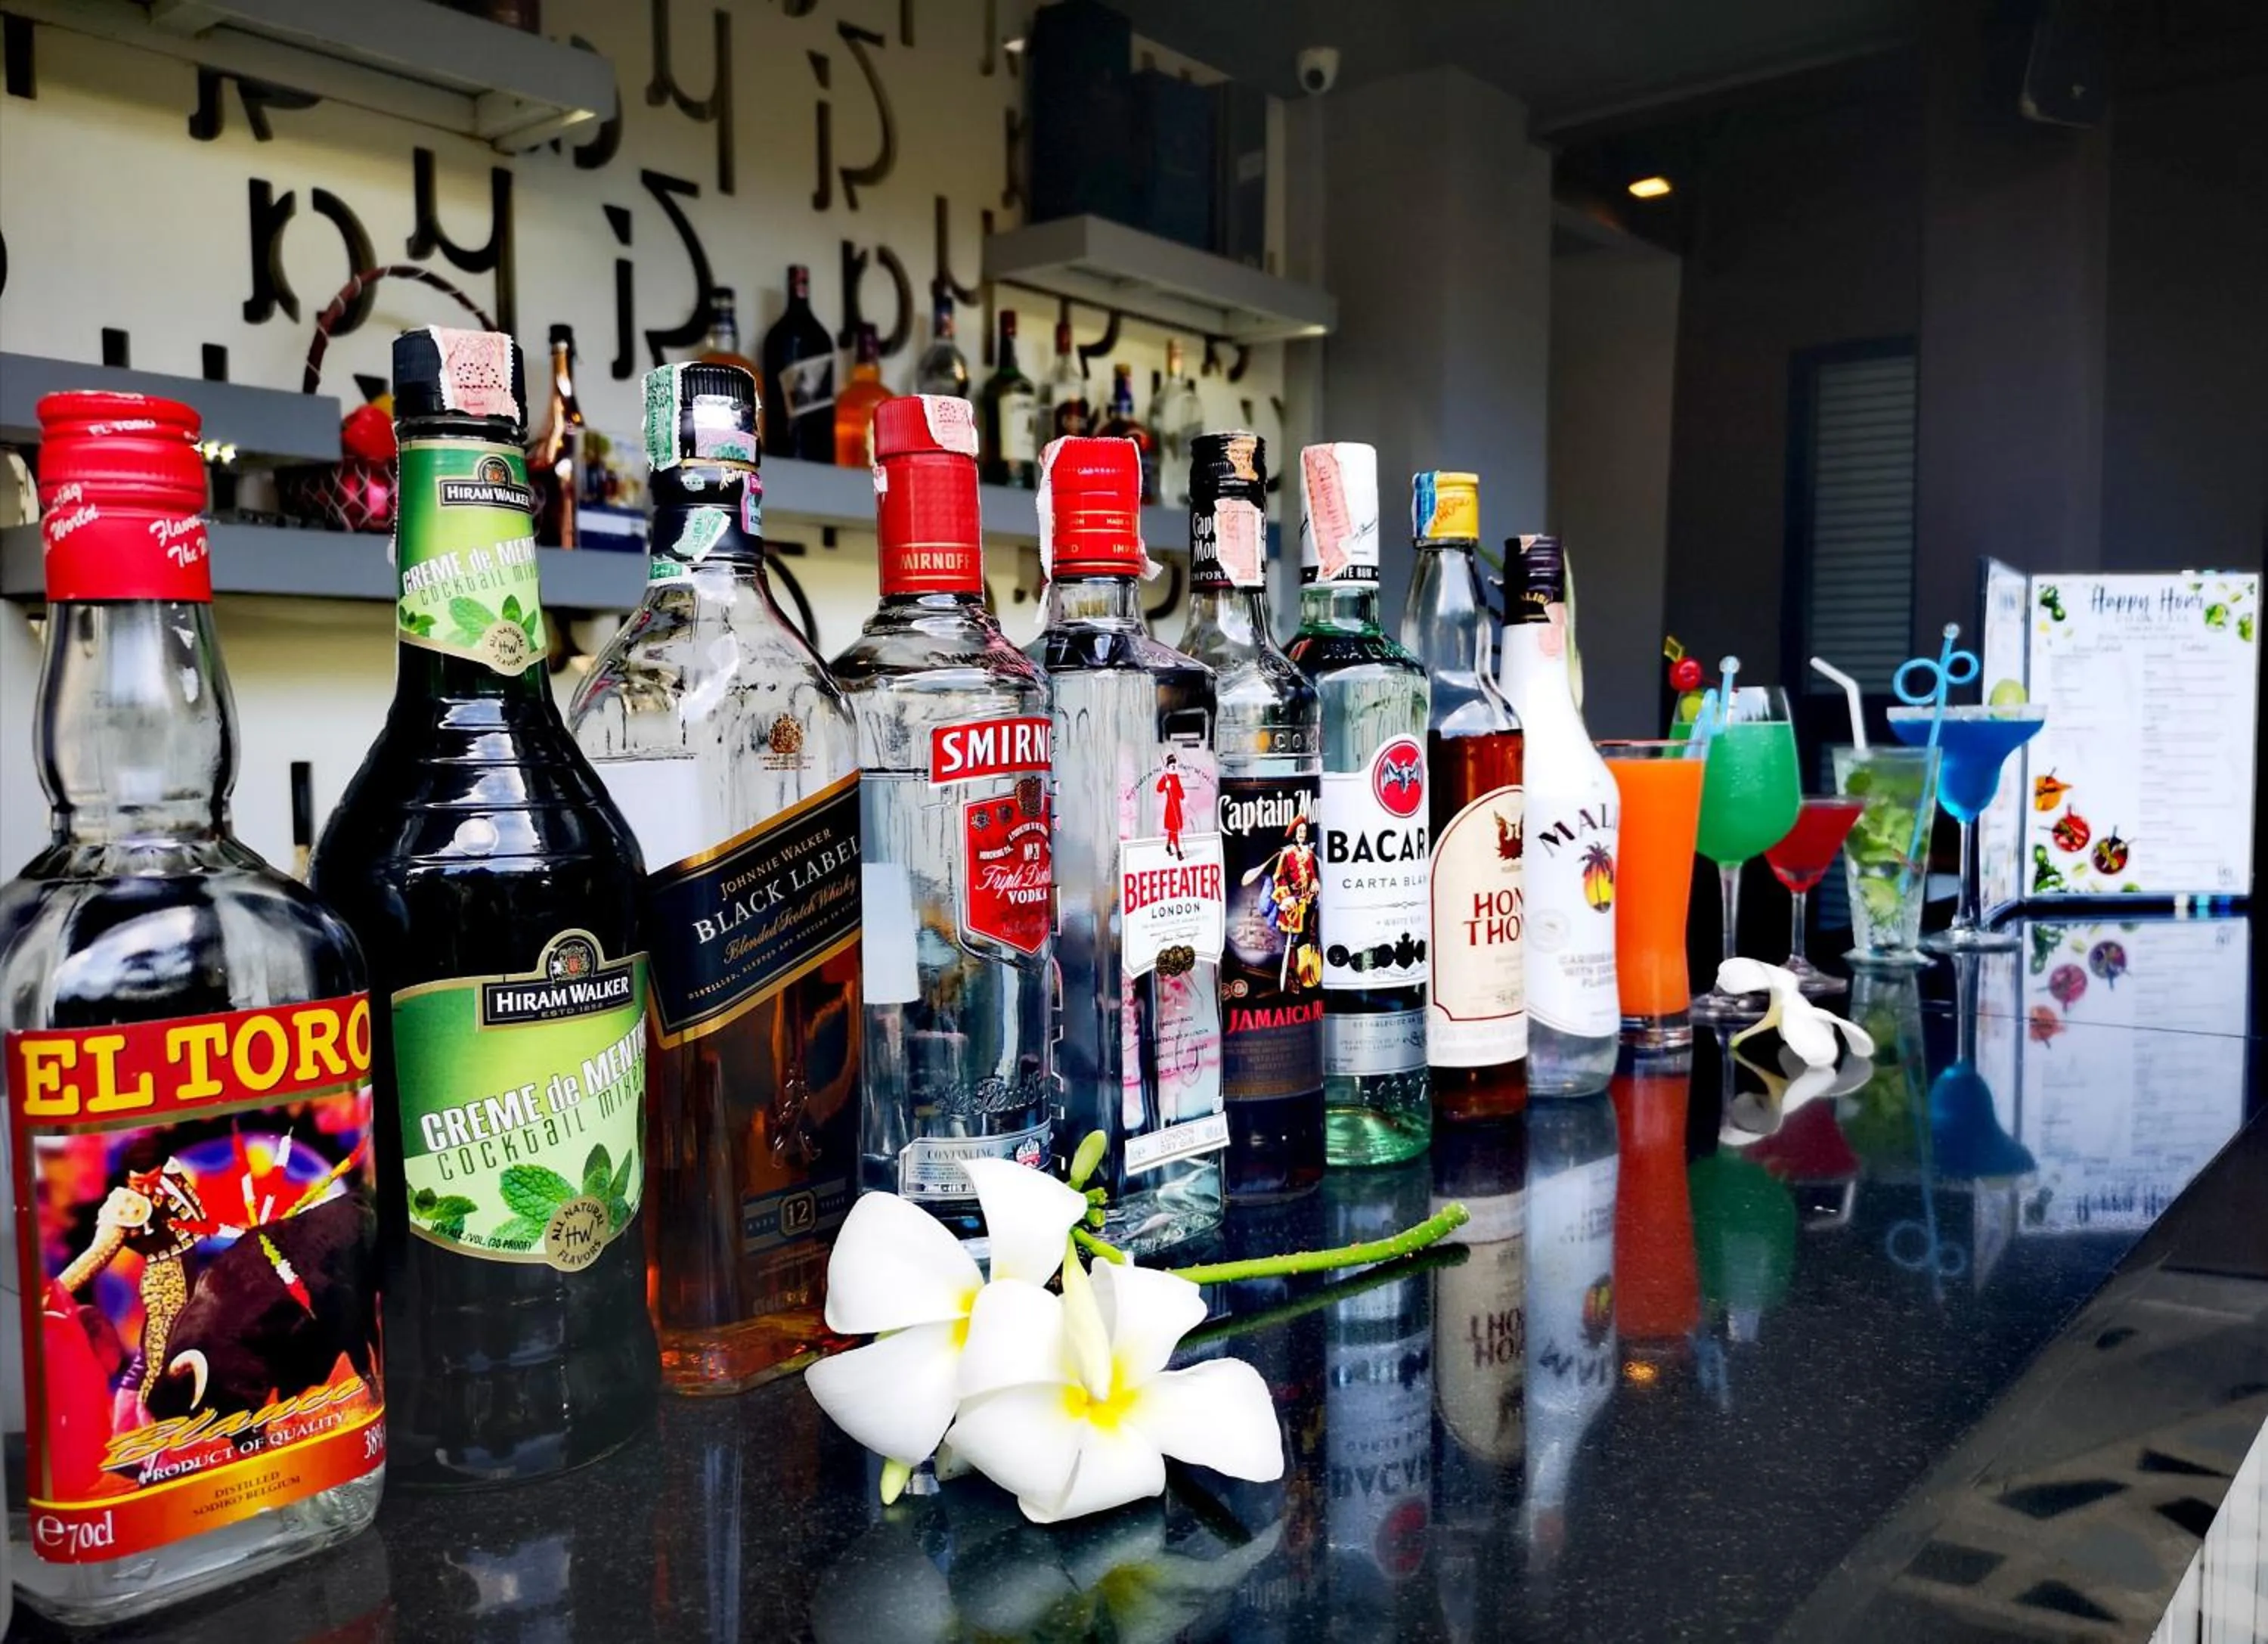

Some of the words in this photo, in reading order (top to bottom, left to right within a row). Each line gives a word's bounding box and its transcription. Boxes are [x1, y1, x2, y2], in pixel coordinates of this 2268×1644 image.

[447, 485, 494, 501] HIRAM
[1192, 512, 1212, 539] Cap
[402, 551, 461, 595] CREME
[469, 547, 493, 571] de
[900, 552, 971, 570] MIRNOFF
[420, 568, 506, 606] cocktail
[2090, 583, 2149, 616] Happy
[1219, 790, 1295, 836] Captain
[720, 856, 779, 901] JOHNNIE
[779, 827, 832, 864] WALKER
[692, 879, 786, 945] BLACK
[789, 834, 860, 893] LABEL
[1124, 864, 1222, 916] BEEFEATER
[1342, 877, 1398, 889] CARTA
[1151, 903, 1201, 920] LONDON
[723, 922, 779, 965] Blended
[496, 988, 568, 1013] HIRAM
[569, 976, 630, 1003] WALKER
[20, 1034, 155, 1116] EL
[166, 998, 372, 1100] TORO
[420, 1082, 546, 1153] CREME
[546, 1072, 581, 1115] de
[435, 1107, 587, 1181] cocktail
[551, 1221, 566, 1242] ALL
[564, 1202, 604, 1229] NATURAL
[787, 1199, 808, 1227] 12
[557, 1239, 602, 1265] FLAVORS
[565, 1219, 595, 1248] HW
[138, 1445, 235, 1486] PRODUCT
[239, 1437, 266, 1455] OF
[268, 1410, 345, 1447] QUALITY
[214, 1469, 280, 1499] DISTILLED
[246, 1475, 301, 1501] BELGIUM
